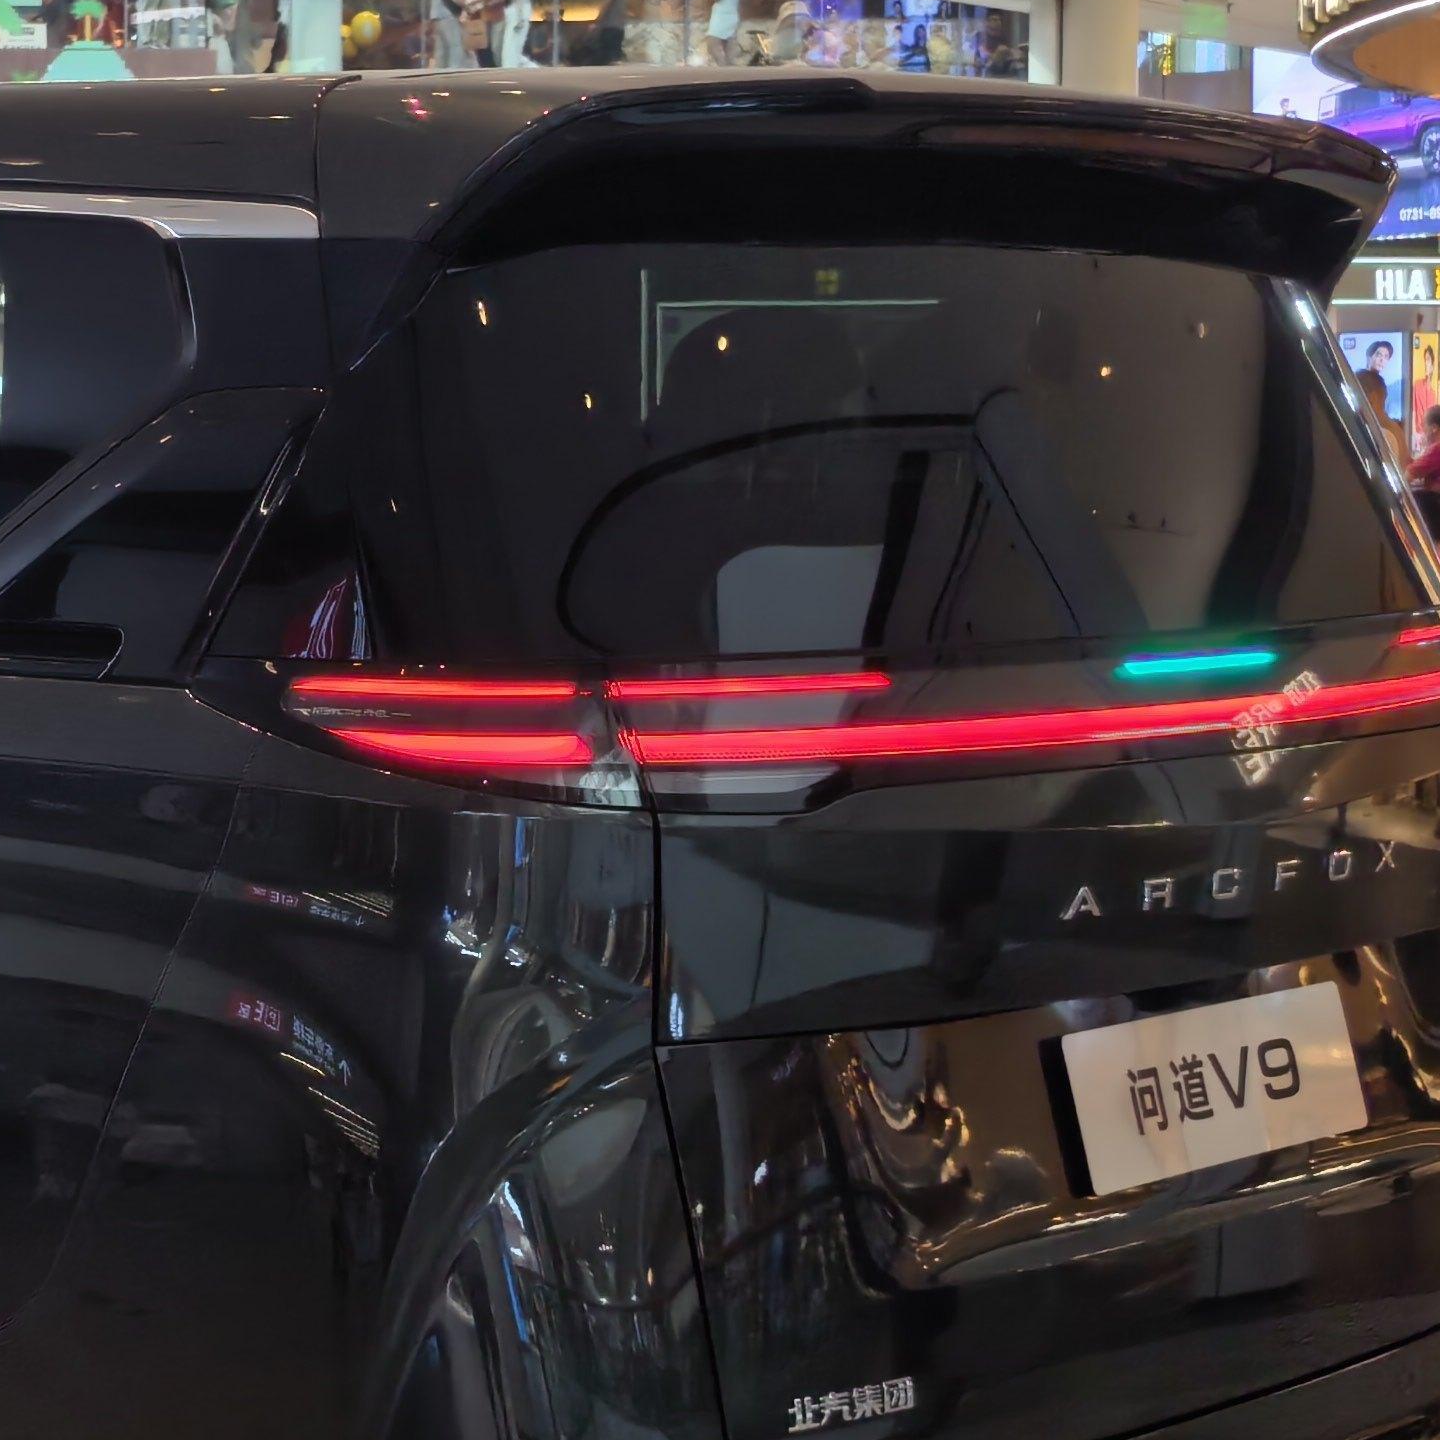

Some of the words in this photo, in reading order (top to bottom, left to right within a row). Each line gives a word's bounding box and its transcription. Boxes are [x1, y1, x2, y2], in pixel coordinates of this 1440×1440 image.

[1375, 268, 1428, 301] HLA
[1058, 839, 1396, 921] ARCFOX
[1126, 1037, 1302, 1136] 问道V9
[787, 1376, 916, 1434] 北汽集团
